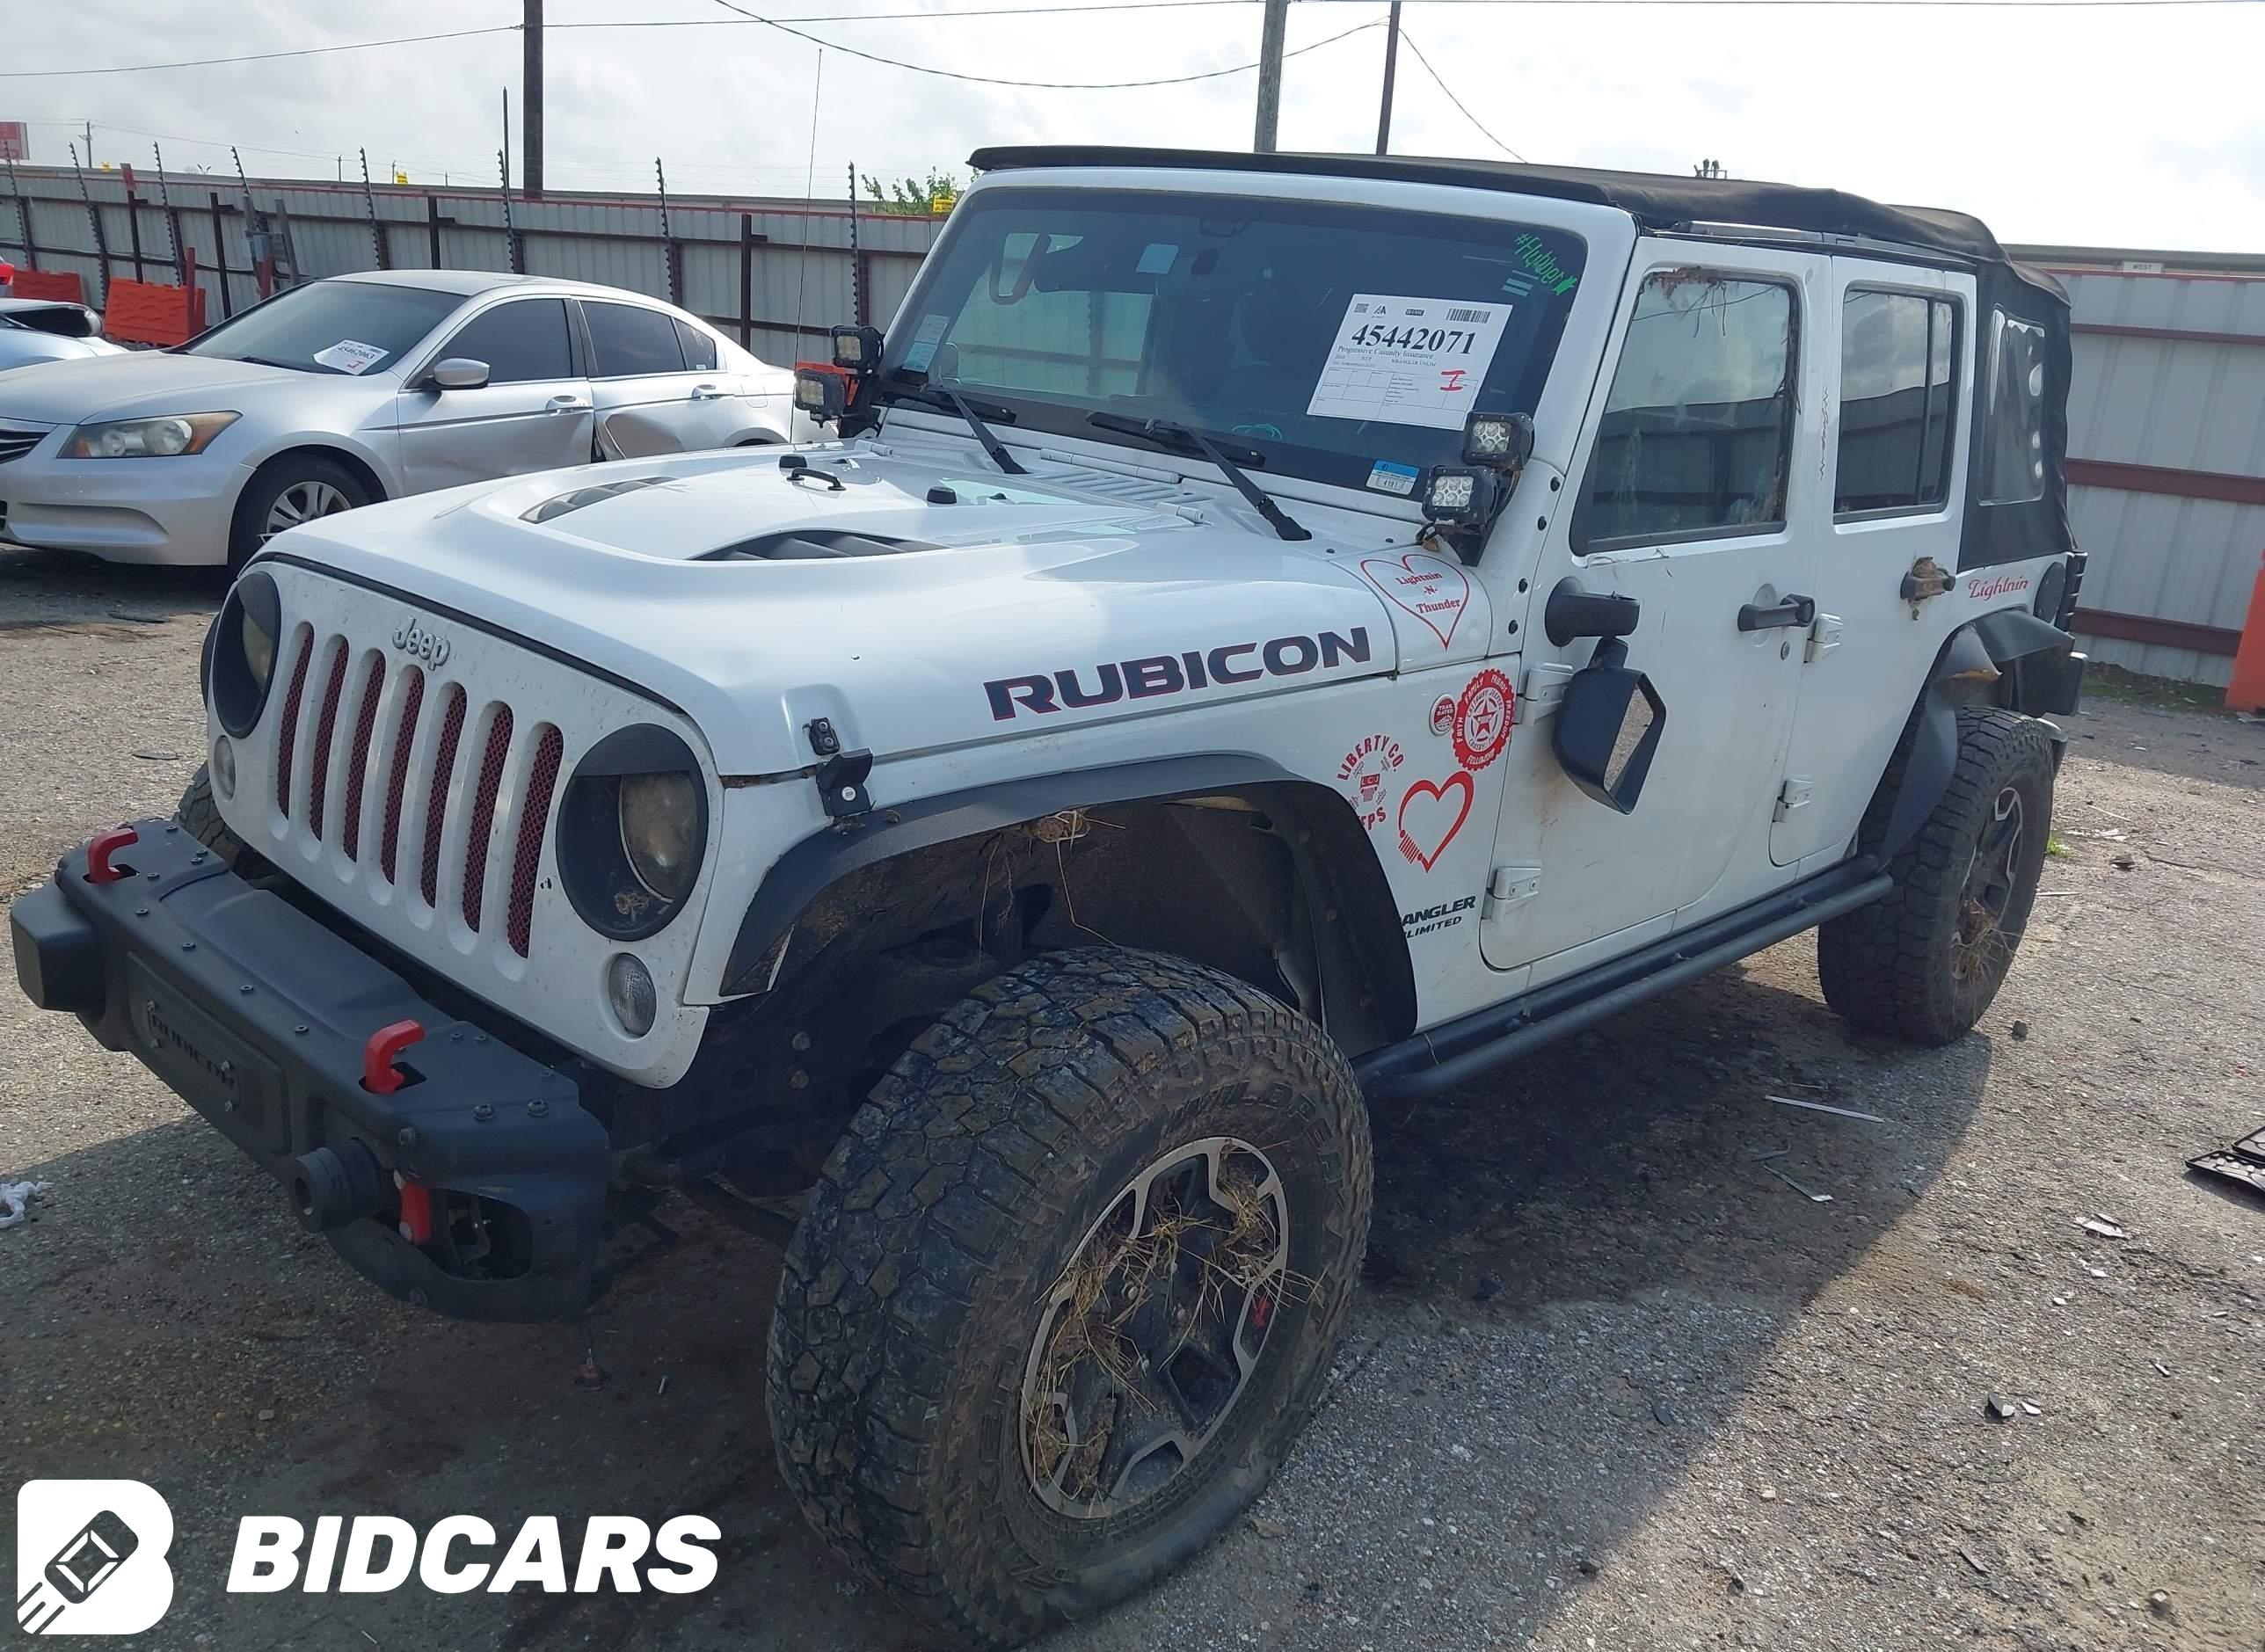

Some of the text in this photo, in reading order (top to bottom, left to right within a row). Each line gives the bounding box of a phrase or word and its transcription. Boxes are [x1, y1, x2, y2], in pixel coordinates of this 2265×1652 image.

[1337, 346, 1434, 360] Progressive Casualty Insurance
[1351, 324, 1476, 354] 45442071
[1395, 571, 1443, 585] Lightnin
[1416, 599, 1460, 614] Thunder
[392, 615, 450, 672] Jeep
[983, 626, 1372, 722] RUBICON
[1465, 676, 1484, 704] FAMILY
[1336, 735, 1390, 780] LIBERTY
[1387, 744, 1404, 772] CO.
[1358, 806, 1387, 830] EPS
[1402, 896, 1476, 927] ANGLER
[1406, 916, 1462, 938] LIMITED
